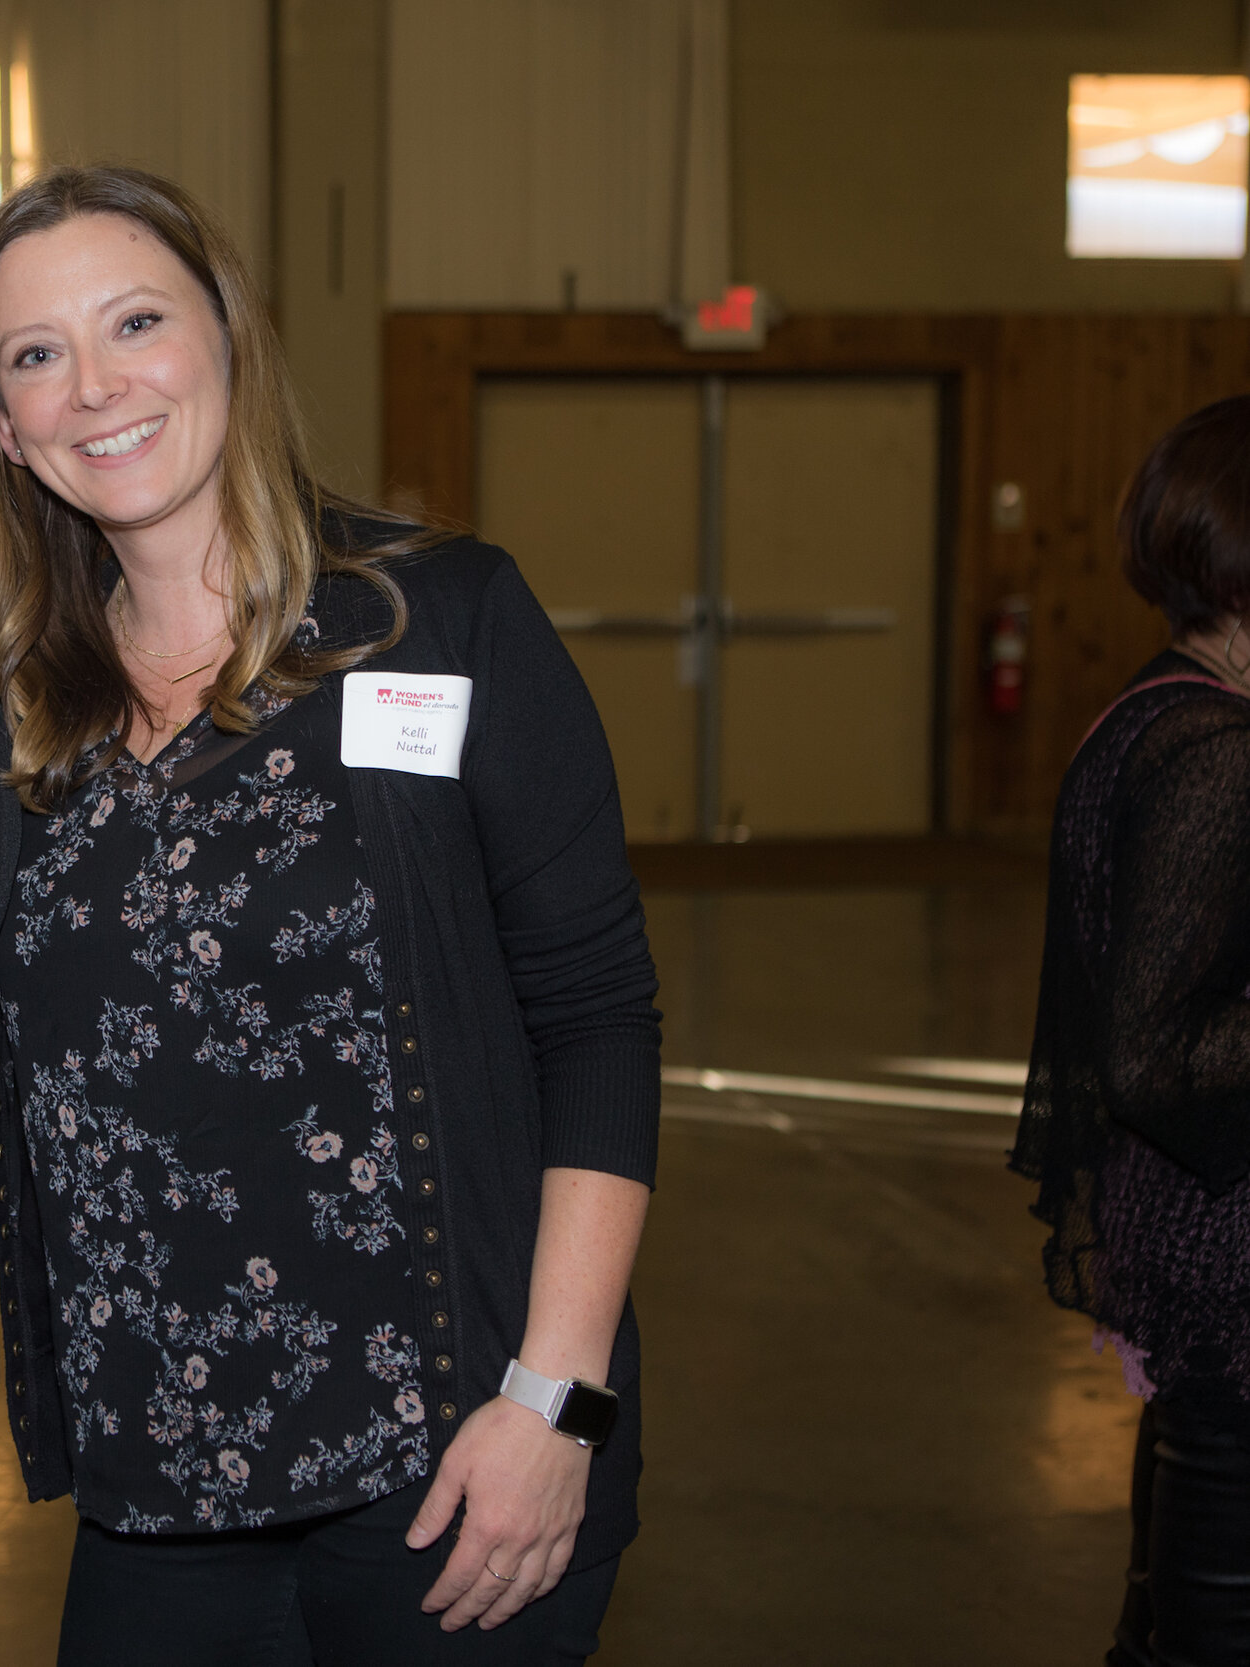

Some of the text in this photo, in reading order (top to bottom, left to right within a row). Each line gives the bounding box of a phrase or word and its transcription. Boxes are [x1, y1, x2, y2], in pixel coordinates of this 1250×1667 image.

[395, 690, 444, 701] WOMEN'S
[395, 698, 422, 707] FUND
[401, 726, 429, 739] Kelli
[396, 741, 437, 756] Nuttal
